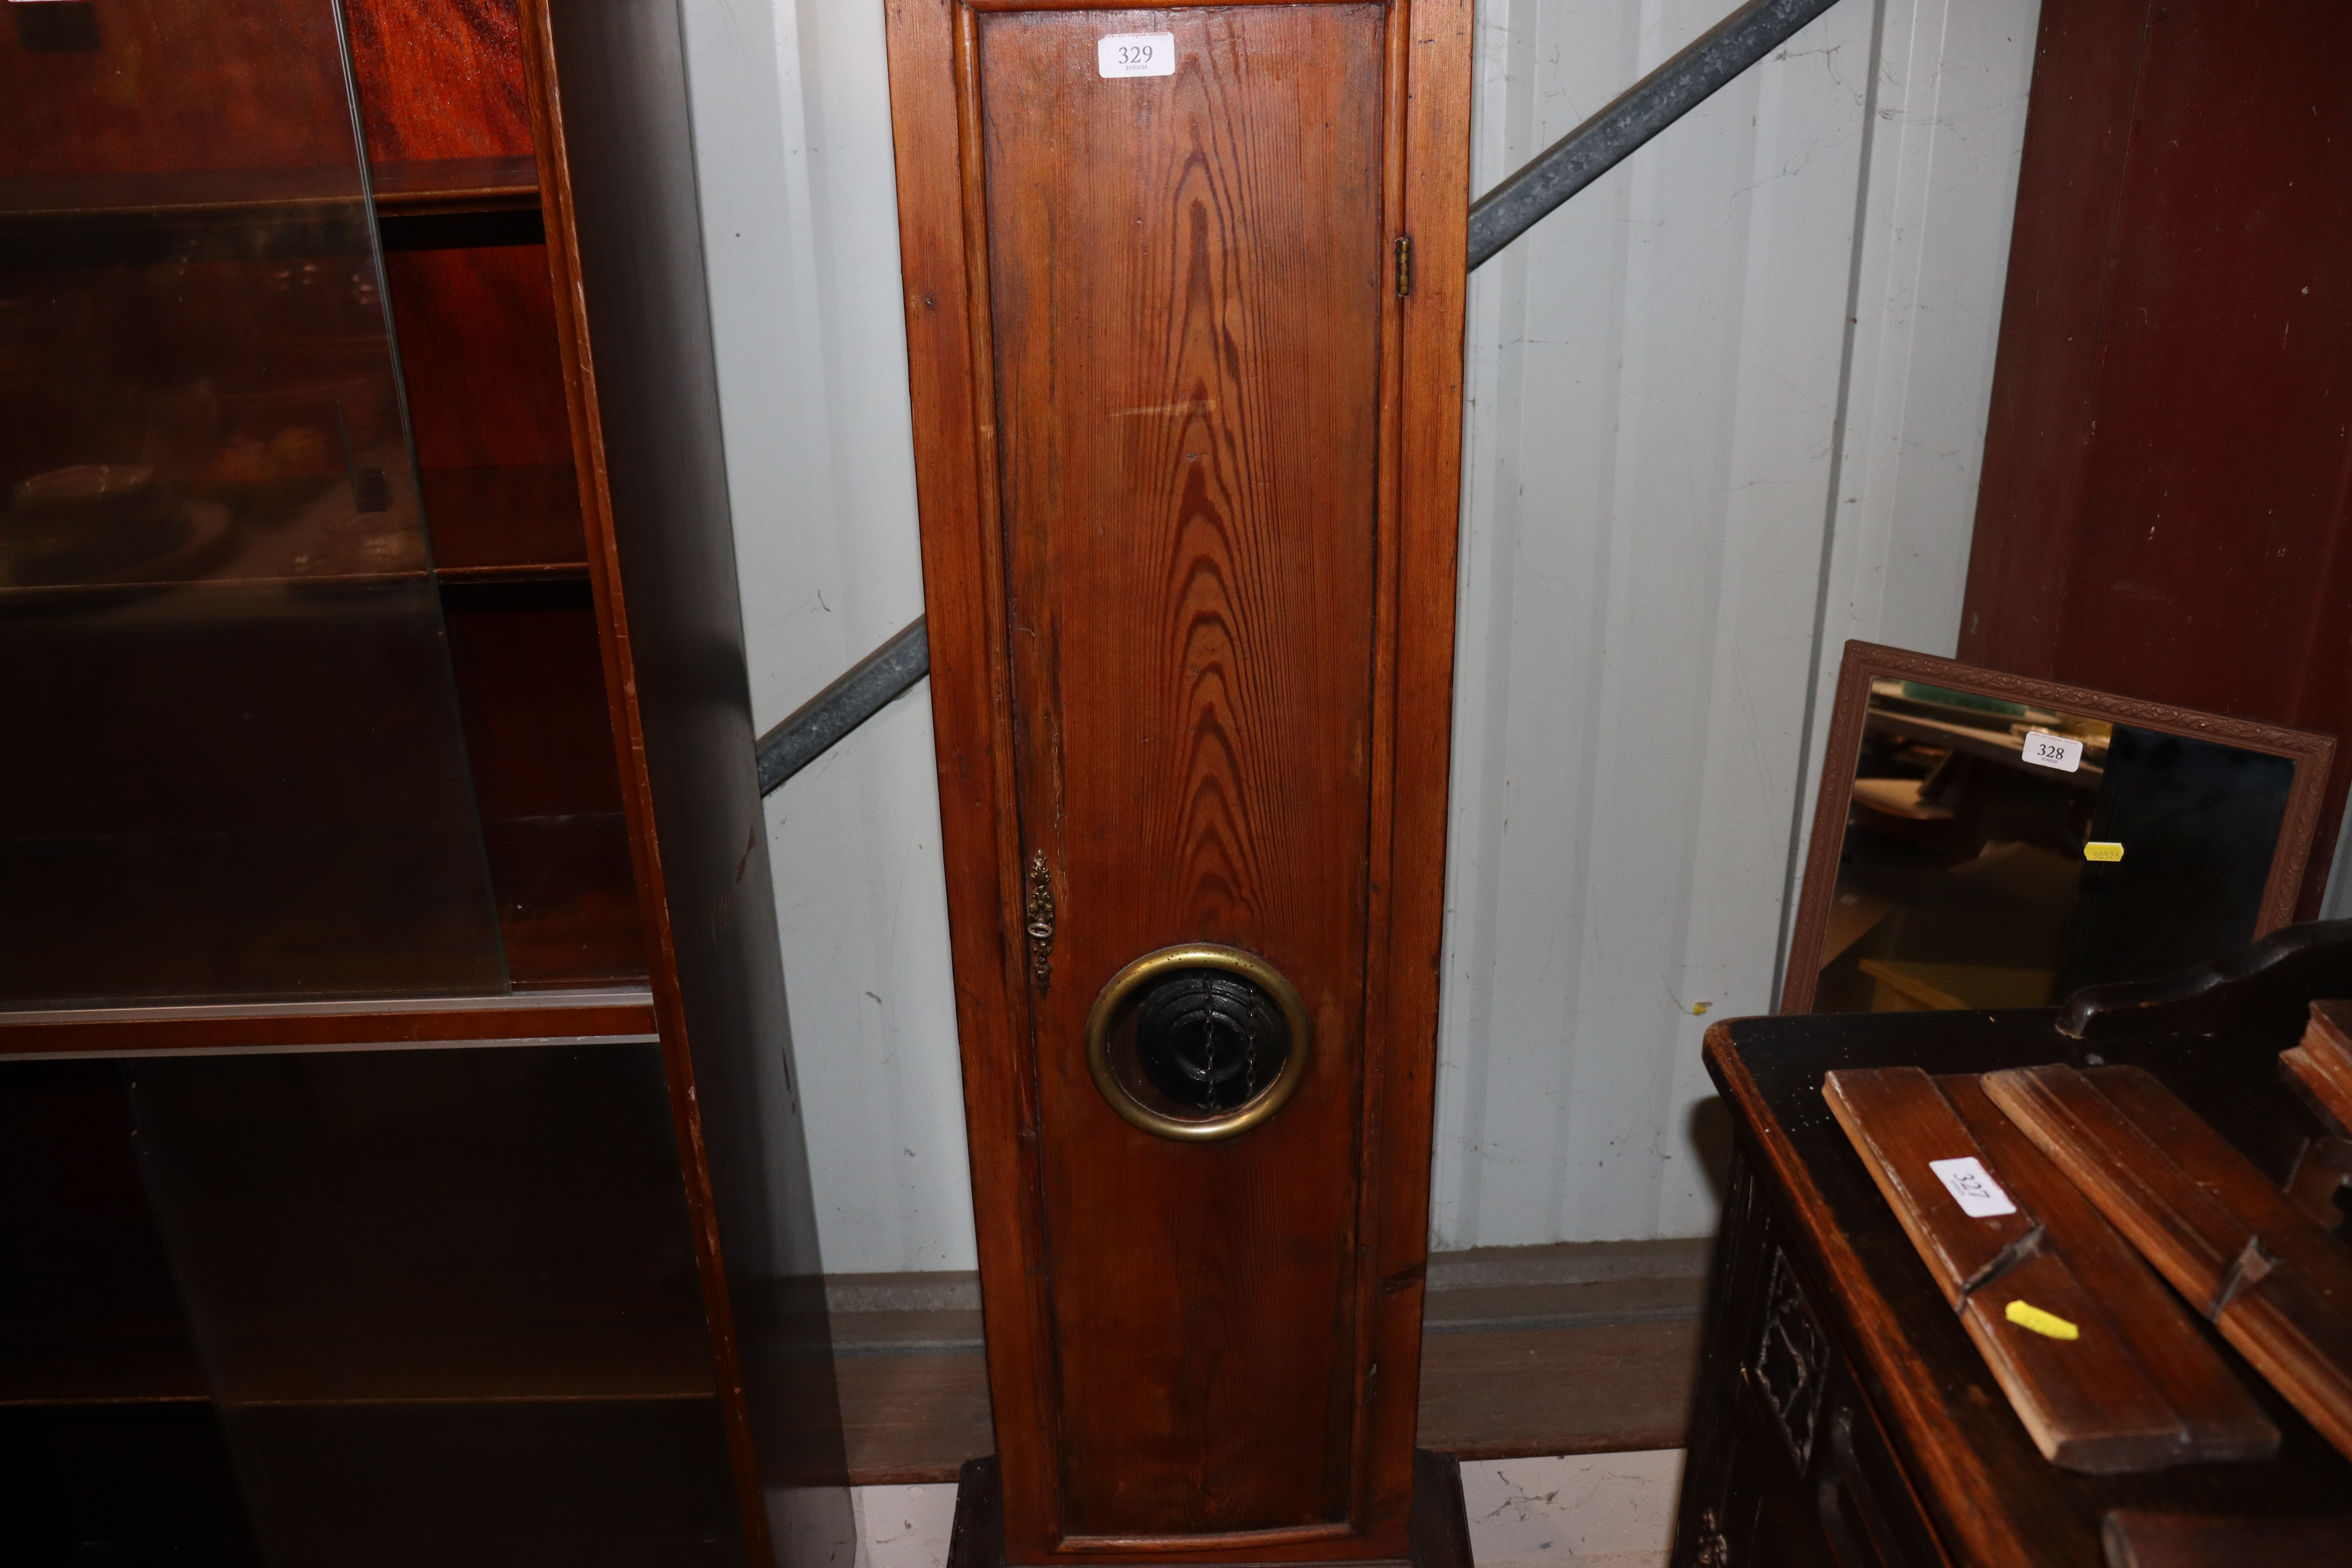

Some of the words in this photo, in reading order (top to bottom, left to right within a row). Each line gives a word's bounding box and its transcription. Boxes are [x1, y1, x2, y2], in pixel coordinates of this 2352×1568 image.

[1118, 46, 1152, 64] 329
[2037, 744, 2064, 760] 328
[2094, 851, 2120, 860] 50526
[1954, 1173, 1990, 1198] 327
